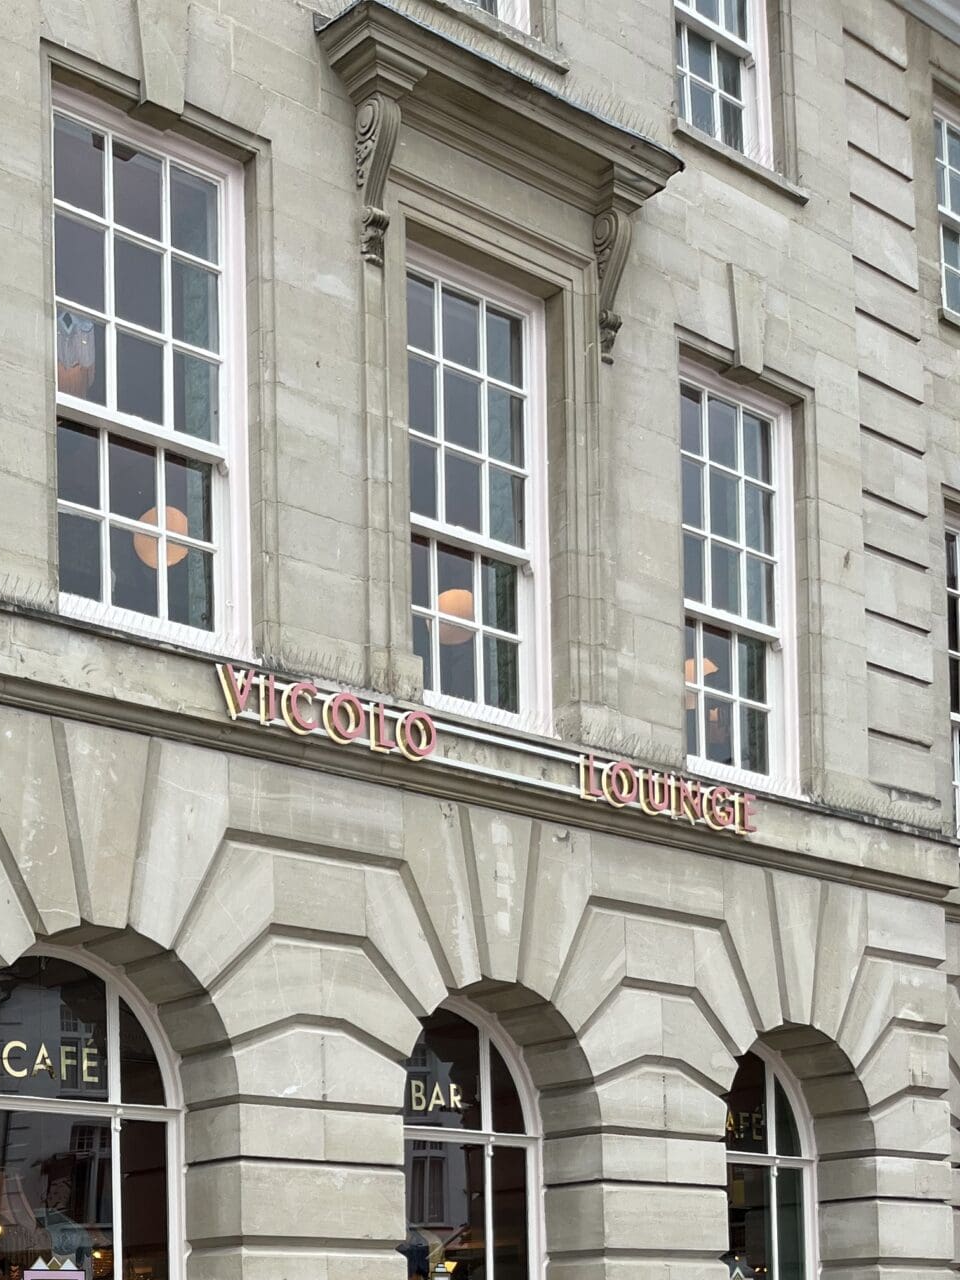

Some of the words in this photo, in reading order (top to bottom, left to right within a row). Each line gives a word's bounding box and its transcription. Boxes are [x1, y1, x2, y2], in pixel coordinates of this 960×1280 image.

[215, 663, 437, 762] VICOLO
[579, 752, 759, 836] LOUNGE
[1, 1036, 100, 1084] CAFÉ
[410, 1079, 463, 1112] BAR
[726, 1105, 763, 1141] AFÉ
